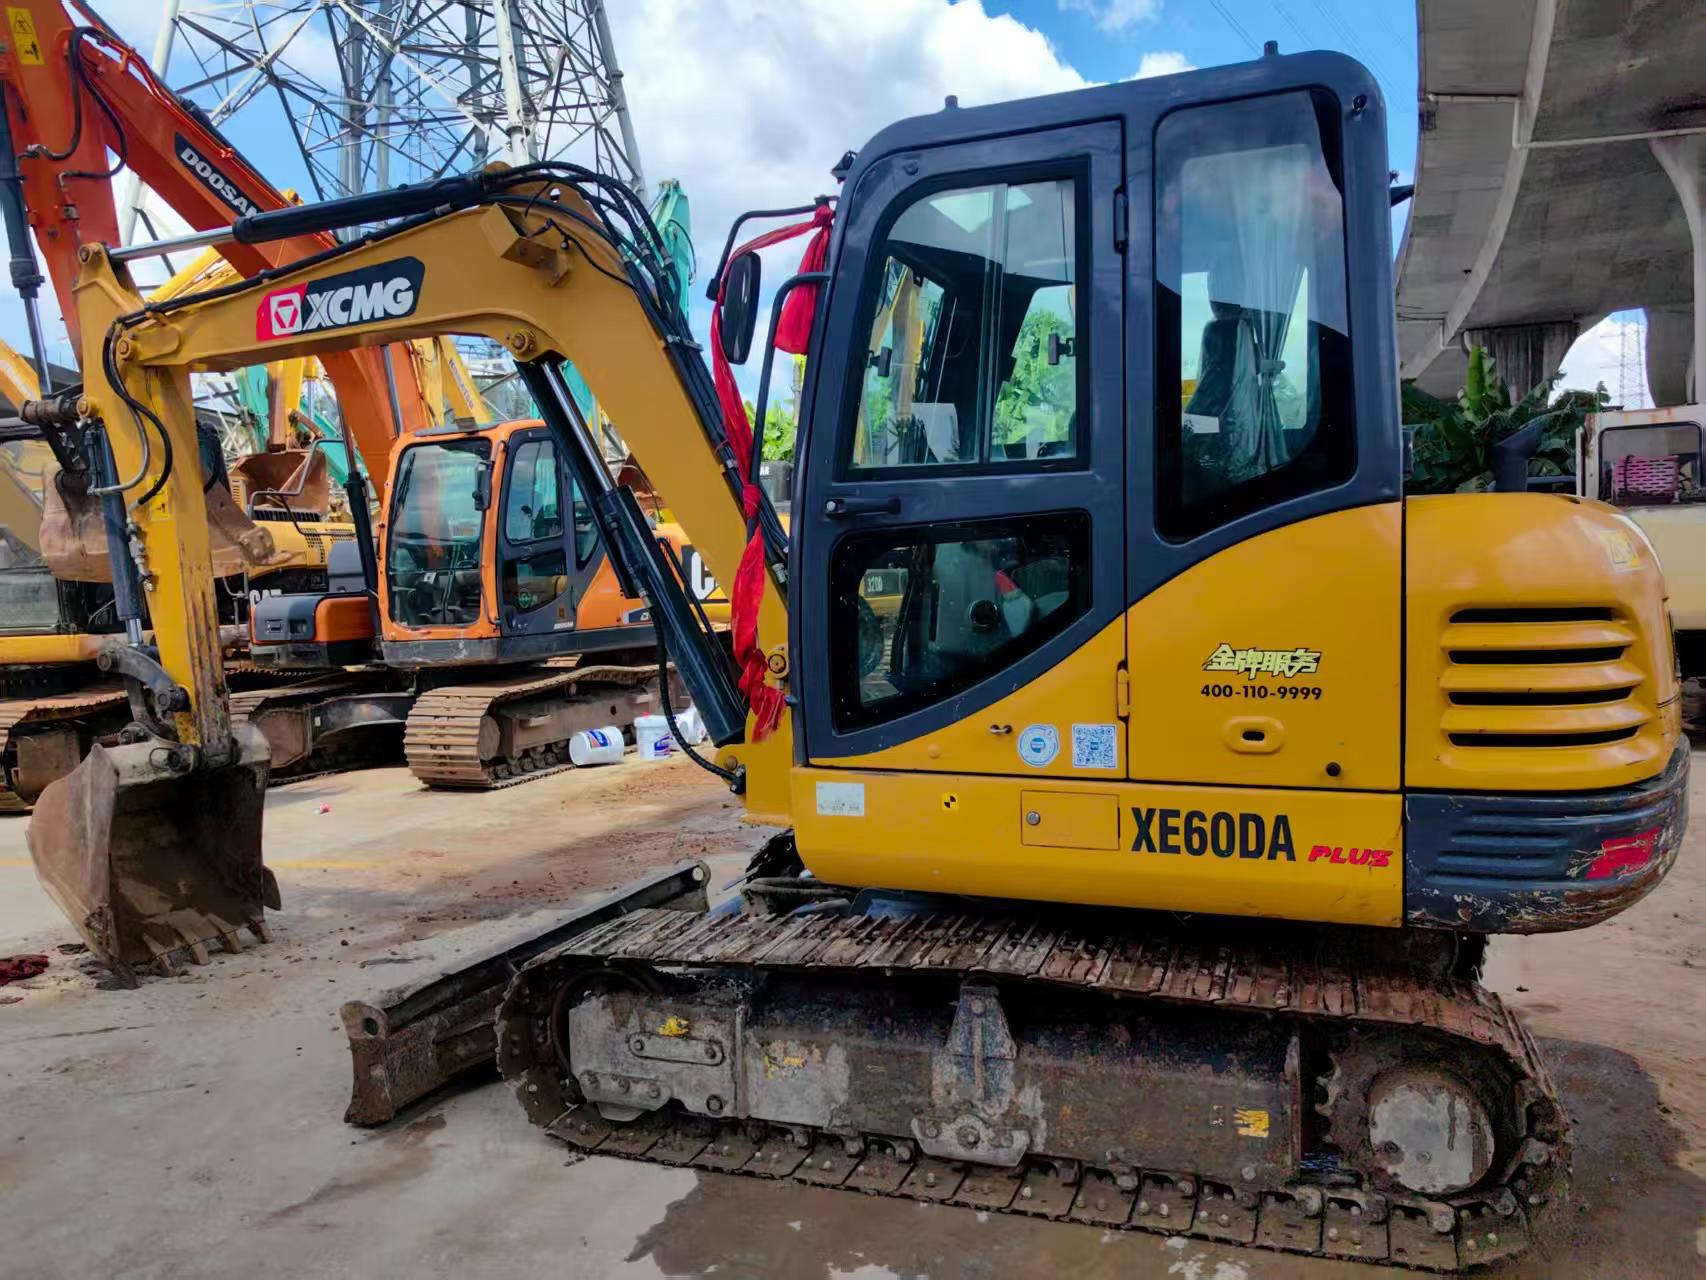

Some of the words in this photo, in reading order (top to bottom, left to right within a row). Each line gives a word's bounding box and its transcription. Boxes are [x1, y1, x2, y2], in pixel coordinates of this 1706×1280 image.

[303, 277, 413, 331] XCMG
[1201, 643, 1322, 681] 金牌服务
[1200, 684, 1322, 699] 400-110-9999
[1131, 807, 1297, 861] XE60DA
[1308, 845, 1393, 867] PLUS
